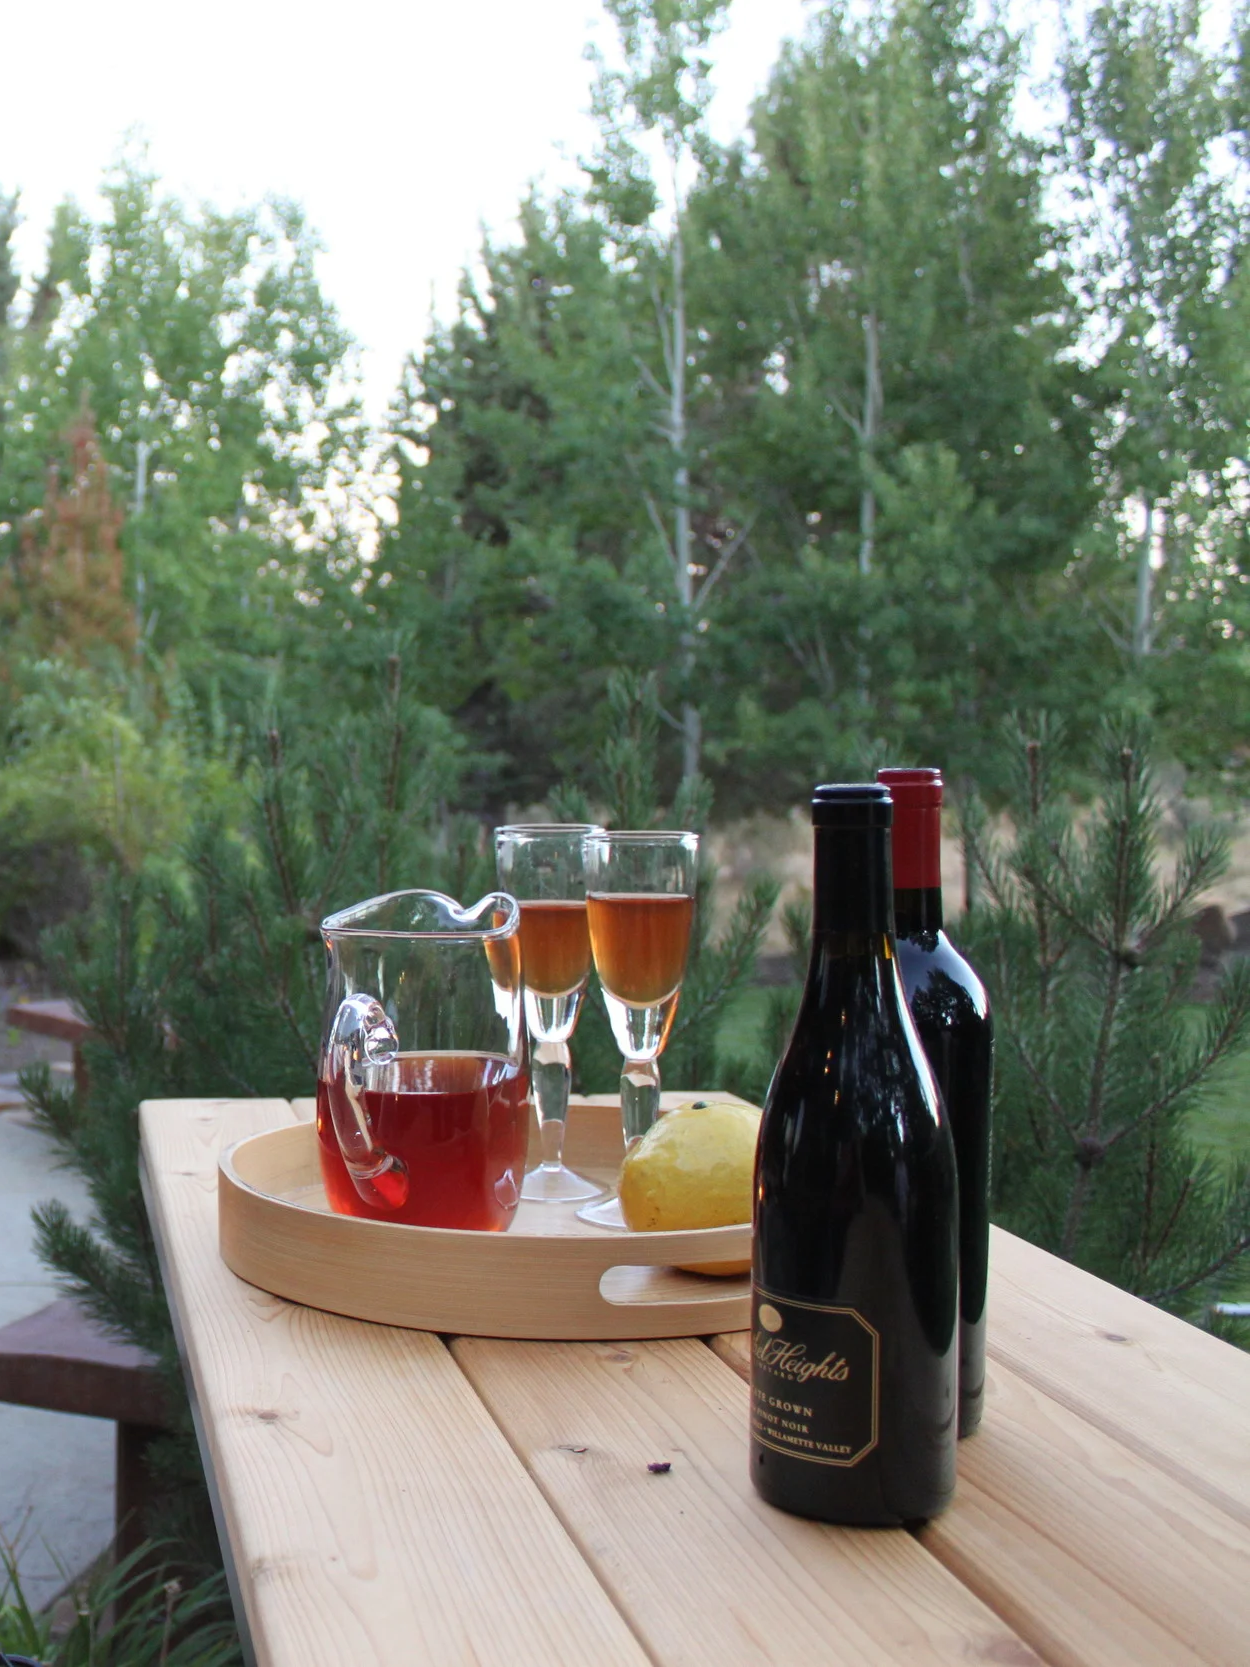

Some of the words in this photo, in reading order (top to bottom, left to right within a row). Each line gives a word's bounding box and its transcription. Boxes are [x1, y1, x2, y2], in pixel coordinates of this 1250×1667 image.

[766, 1339, 849, 1383] Heights
[768, 1396, 812, 1417] GROWN
[756, 1407, 779, 1424] PINOT
[781, 1419, 809, 1434] NOIR
[767, 1427, 814, 1449] WILLAMETTE
[815, 1441, 852, 1454] VALLEY
